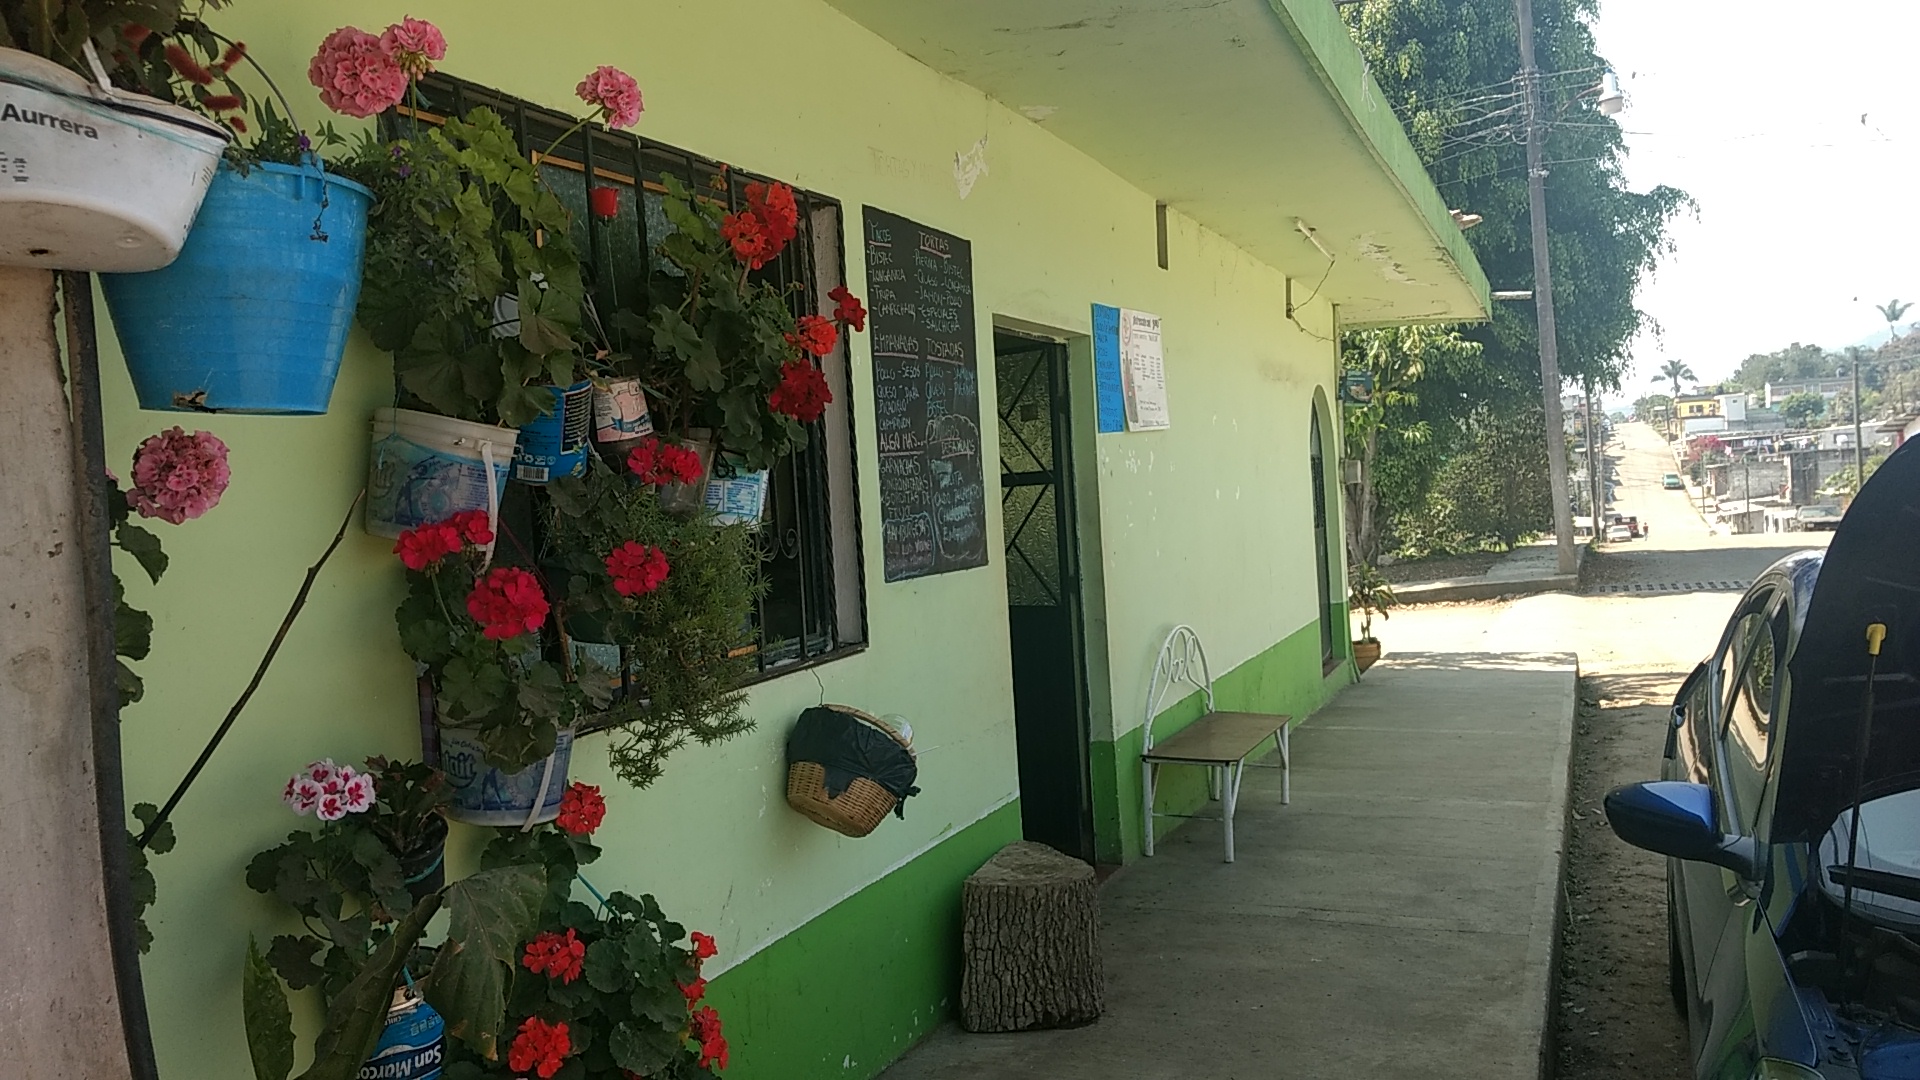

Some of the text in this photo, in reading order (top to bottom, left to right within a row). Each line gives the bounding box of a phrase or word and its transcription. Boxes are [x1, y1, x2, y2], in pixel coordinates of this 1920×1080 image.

[1, 103, 98, 140] Aurrera
[918, 230, 950, 251] TORTAS
[873, 325, 919, 354] EMPANADAS
[925, 337, 964, 358] TOSTADAS
[415, 1044, 442, 1068] San
